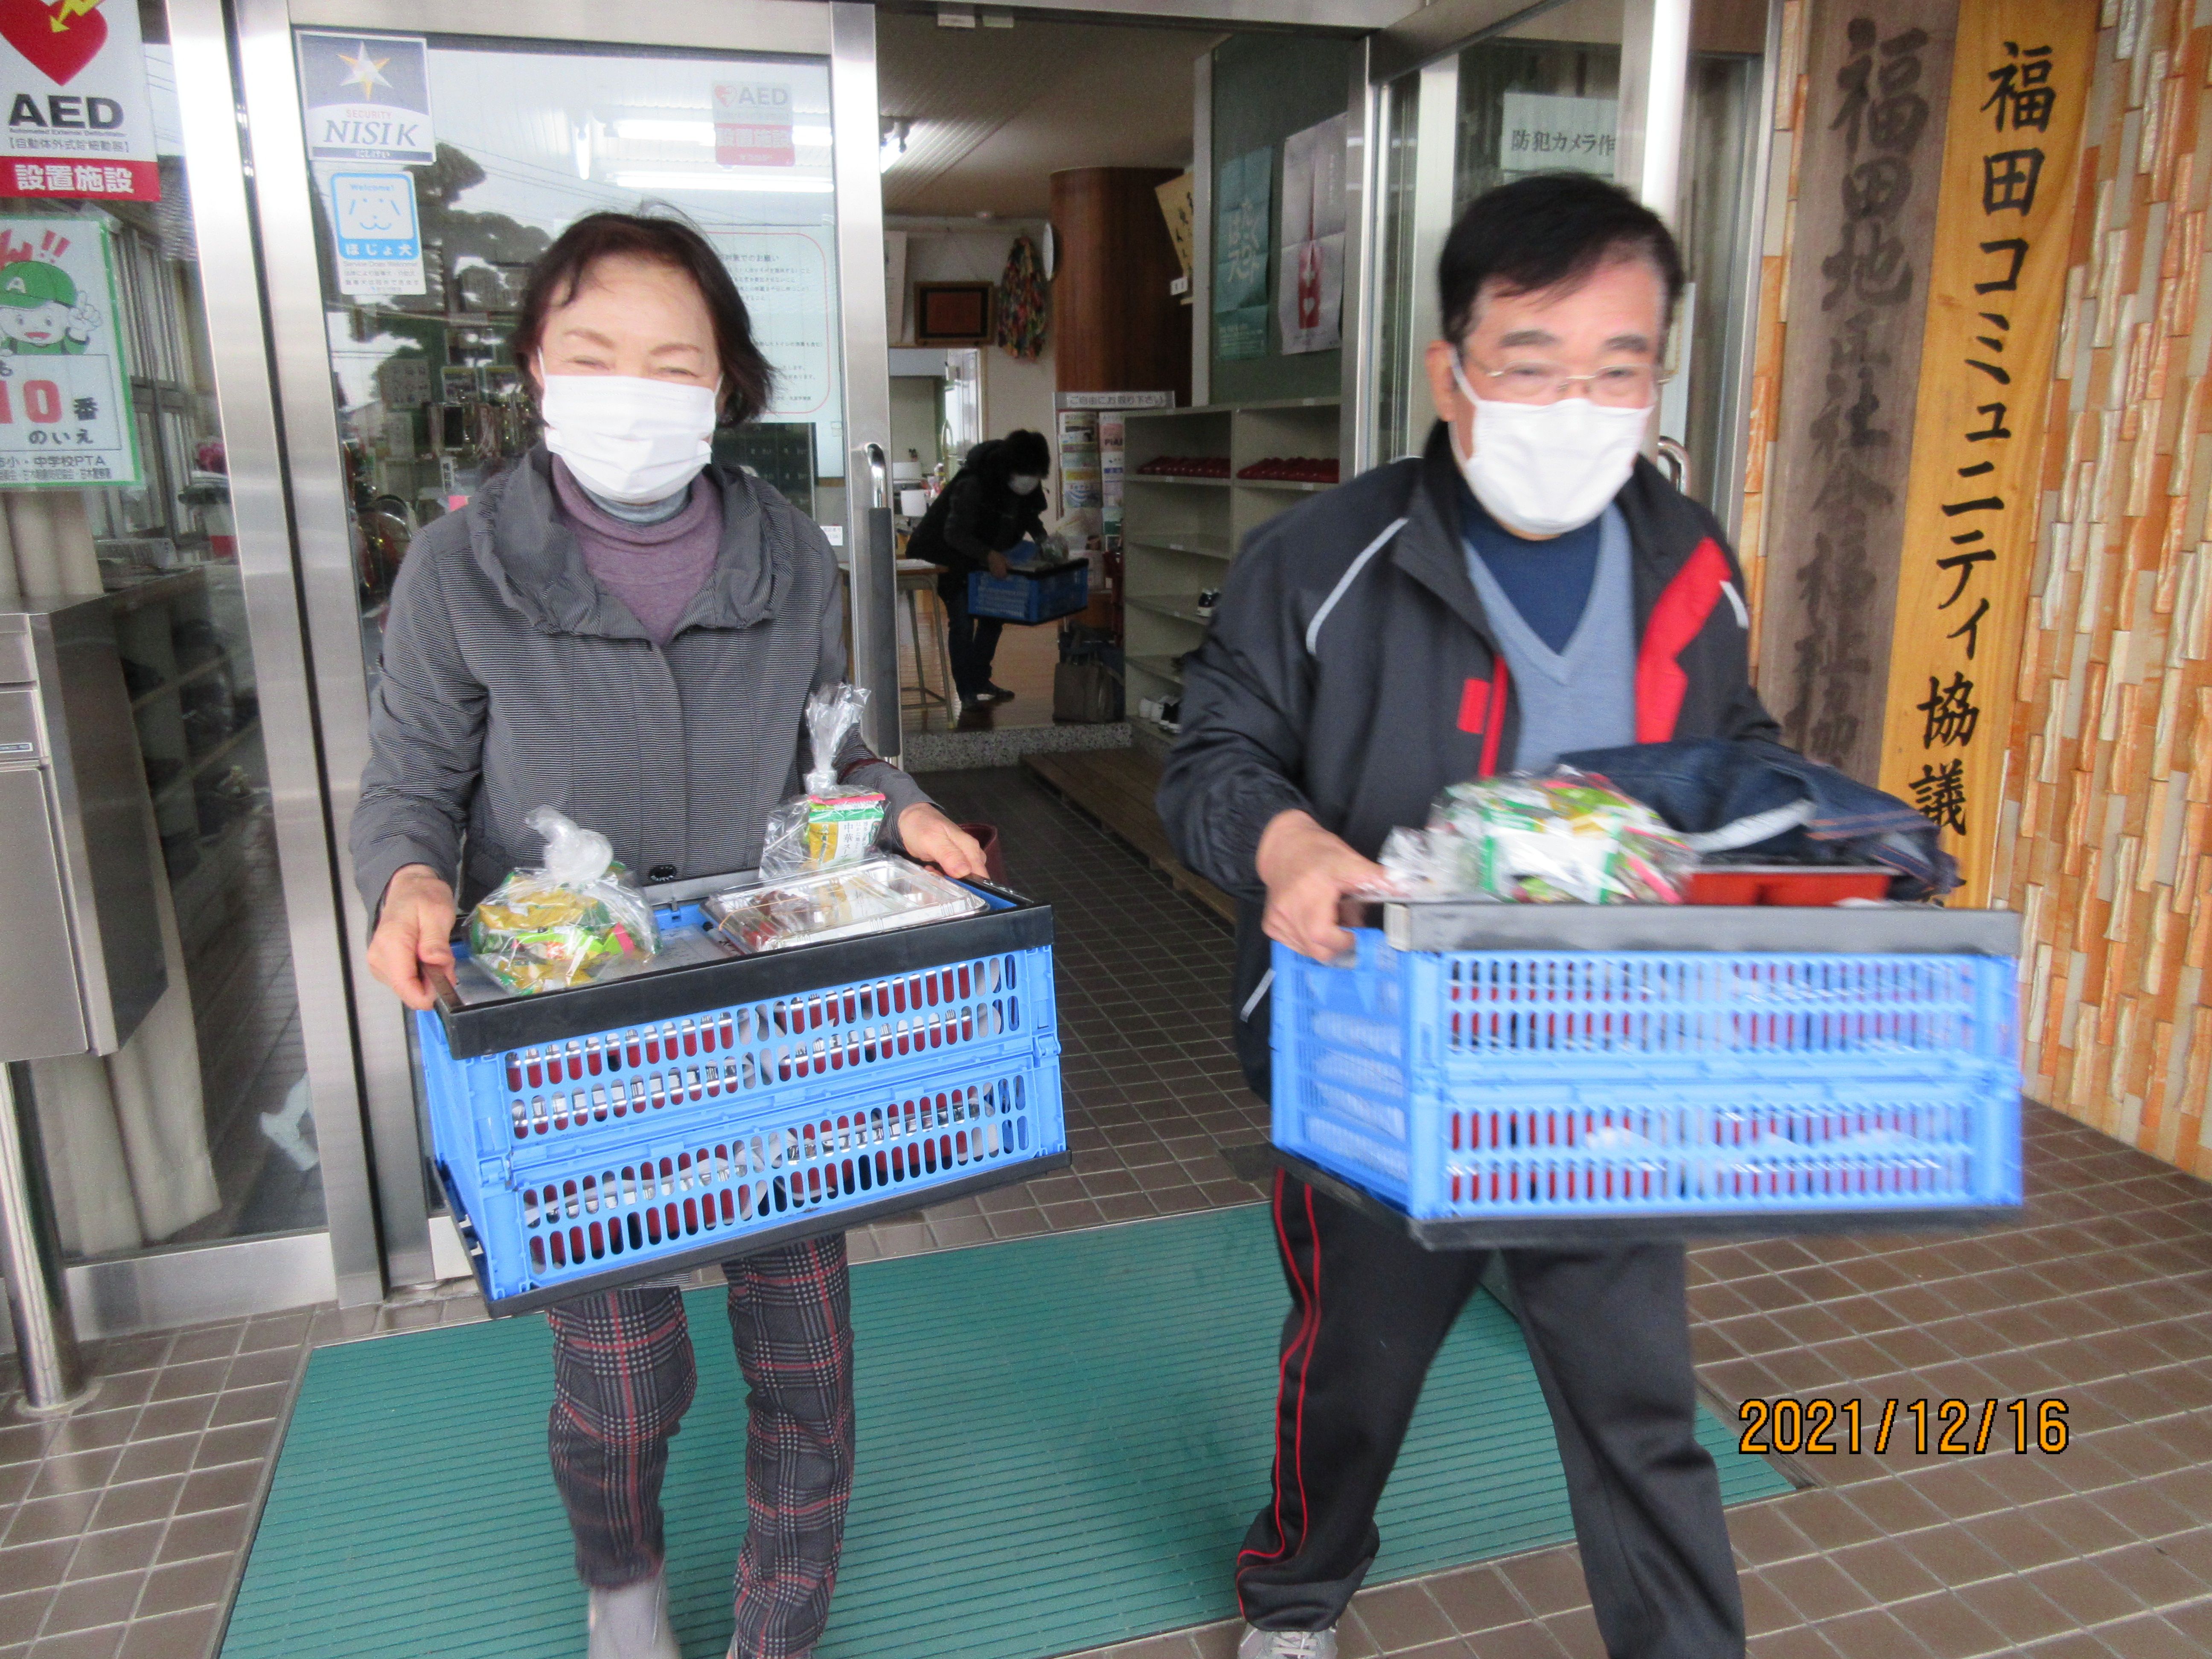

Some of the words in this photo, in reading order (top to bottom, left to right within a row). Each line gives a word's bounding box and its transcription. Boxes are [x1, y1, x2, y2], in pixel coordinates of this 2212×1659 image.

[739, 87, 788, 105] AED
[8, 93, 124, 128] AED
[346, 110, 393, 119] SECURITY
[323, 119, 419, 146] NISIK
[1511, 129, 1616, 156] 防犯カメラ作
[15, 164, 135, 193] 設置施設
[28, 428, 94, 445] のいえ
[1908, 40, 2057, 904] 福田コミュニティ協議
